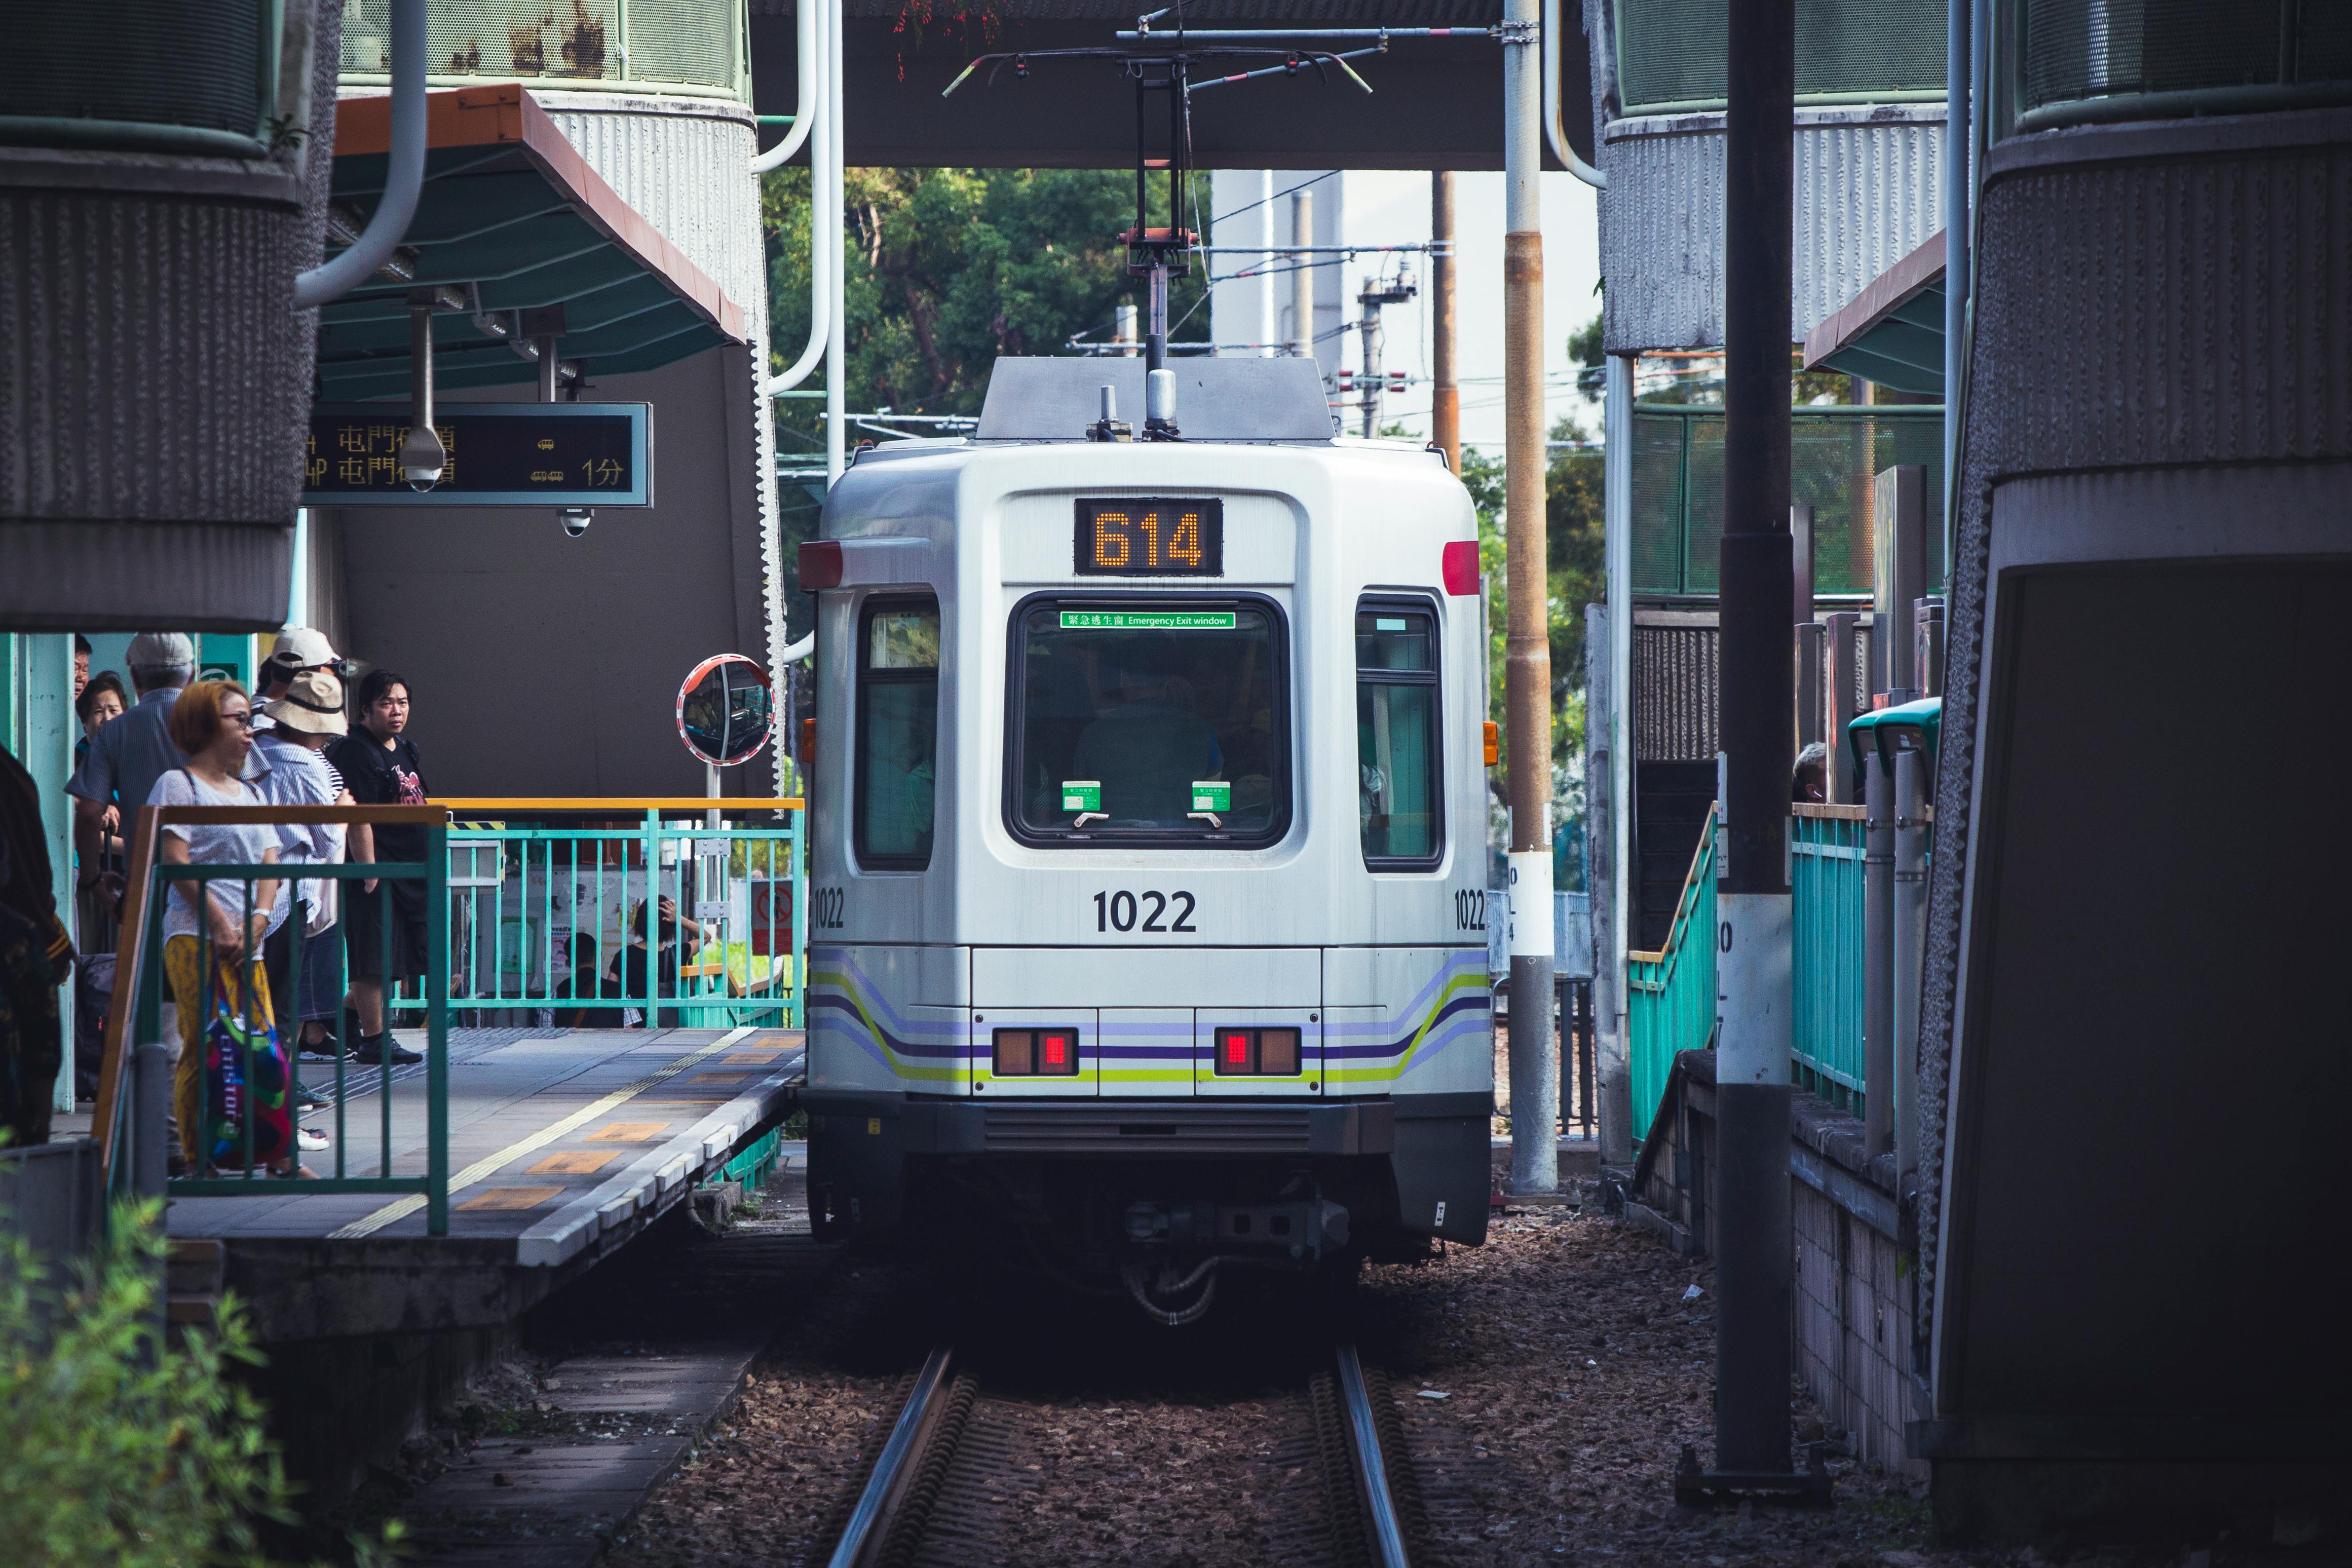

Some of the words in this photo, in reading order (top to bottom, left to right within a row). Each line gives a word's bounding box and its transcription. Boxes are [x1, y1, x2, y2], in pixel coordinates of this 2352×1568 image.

[337, 425, 455, 453] 屯門
[337, 457, 455, 485] 屯門
[1095, 513, 1201, 566] 614
[1128, 617, 1174, 626] Emergency
[1177, 617, 1192, 625] Exit
[1193, 617, 1227, 625] window
[814, 887, 844, 929] 1022
[1093, 890, 1197, 933] 1022
[1455, 889, 1486, 931] 1022
